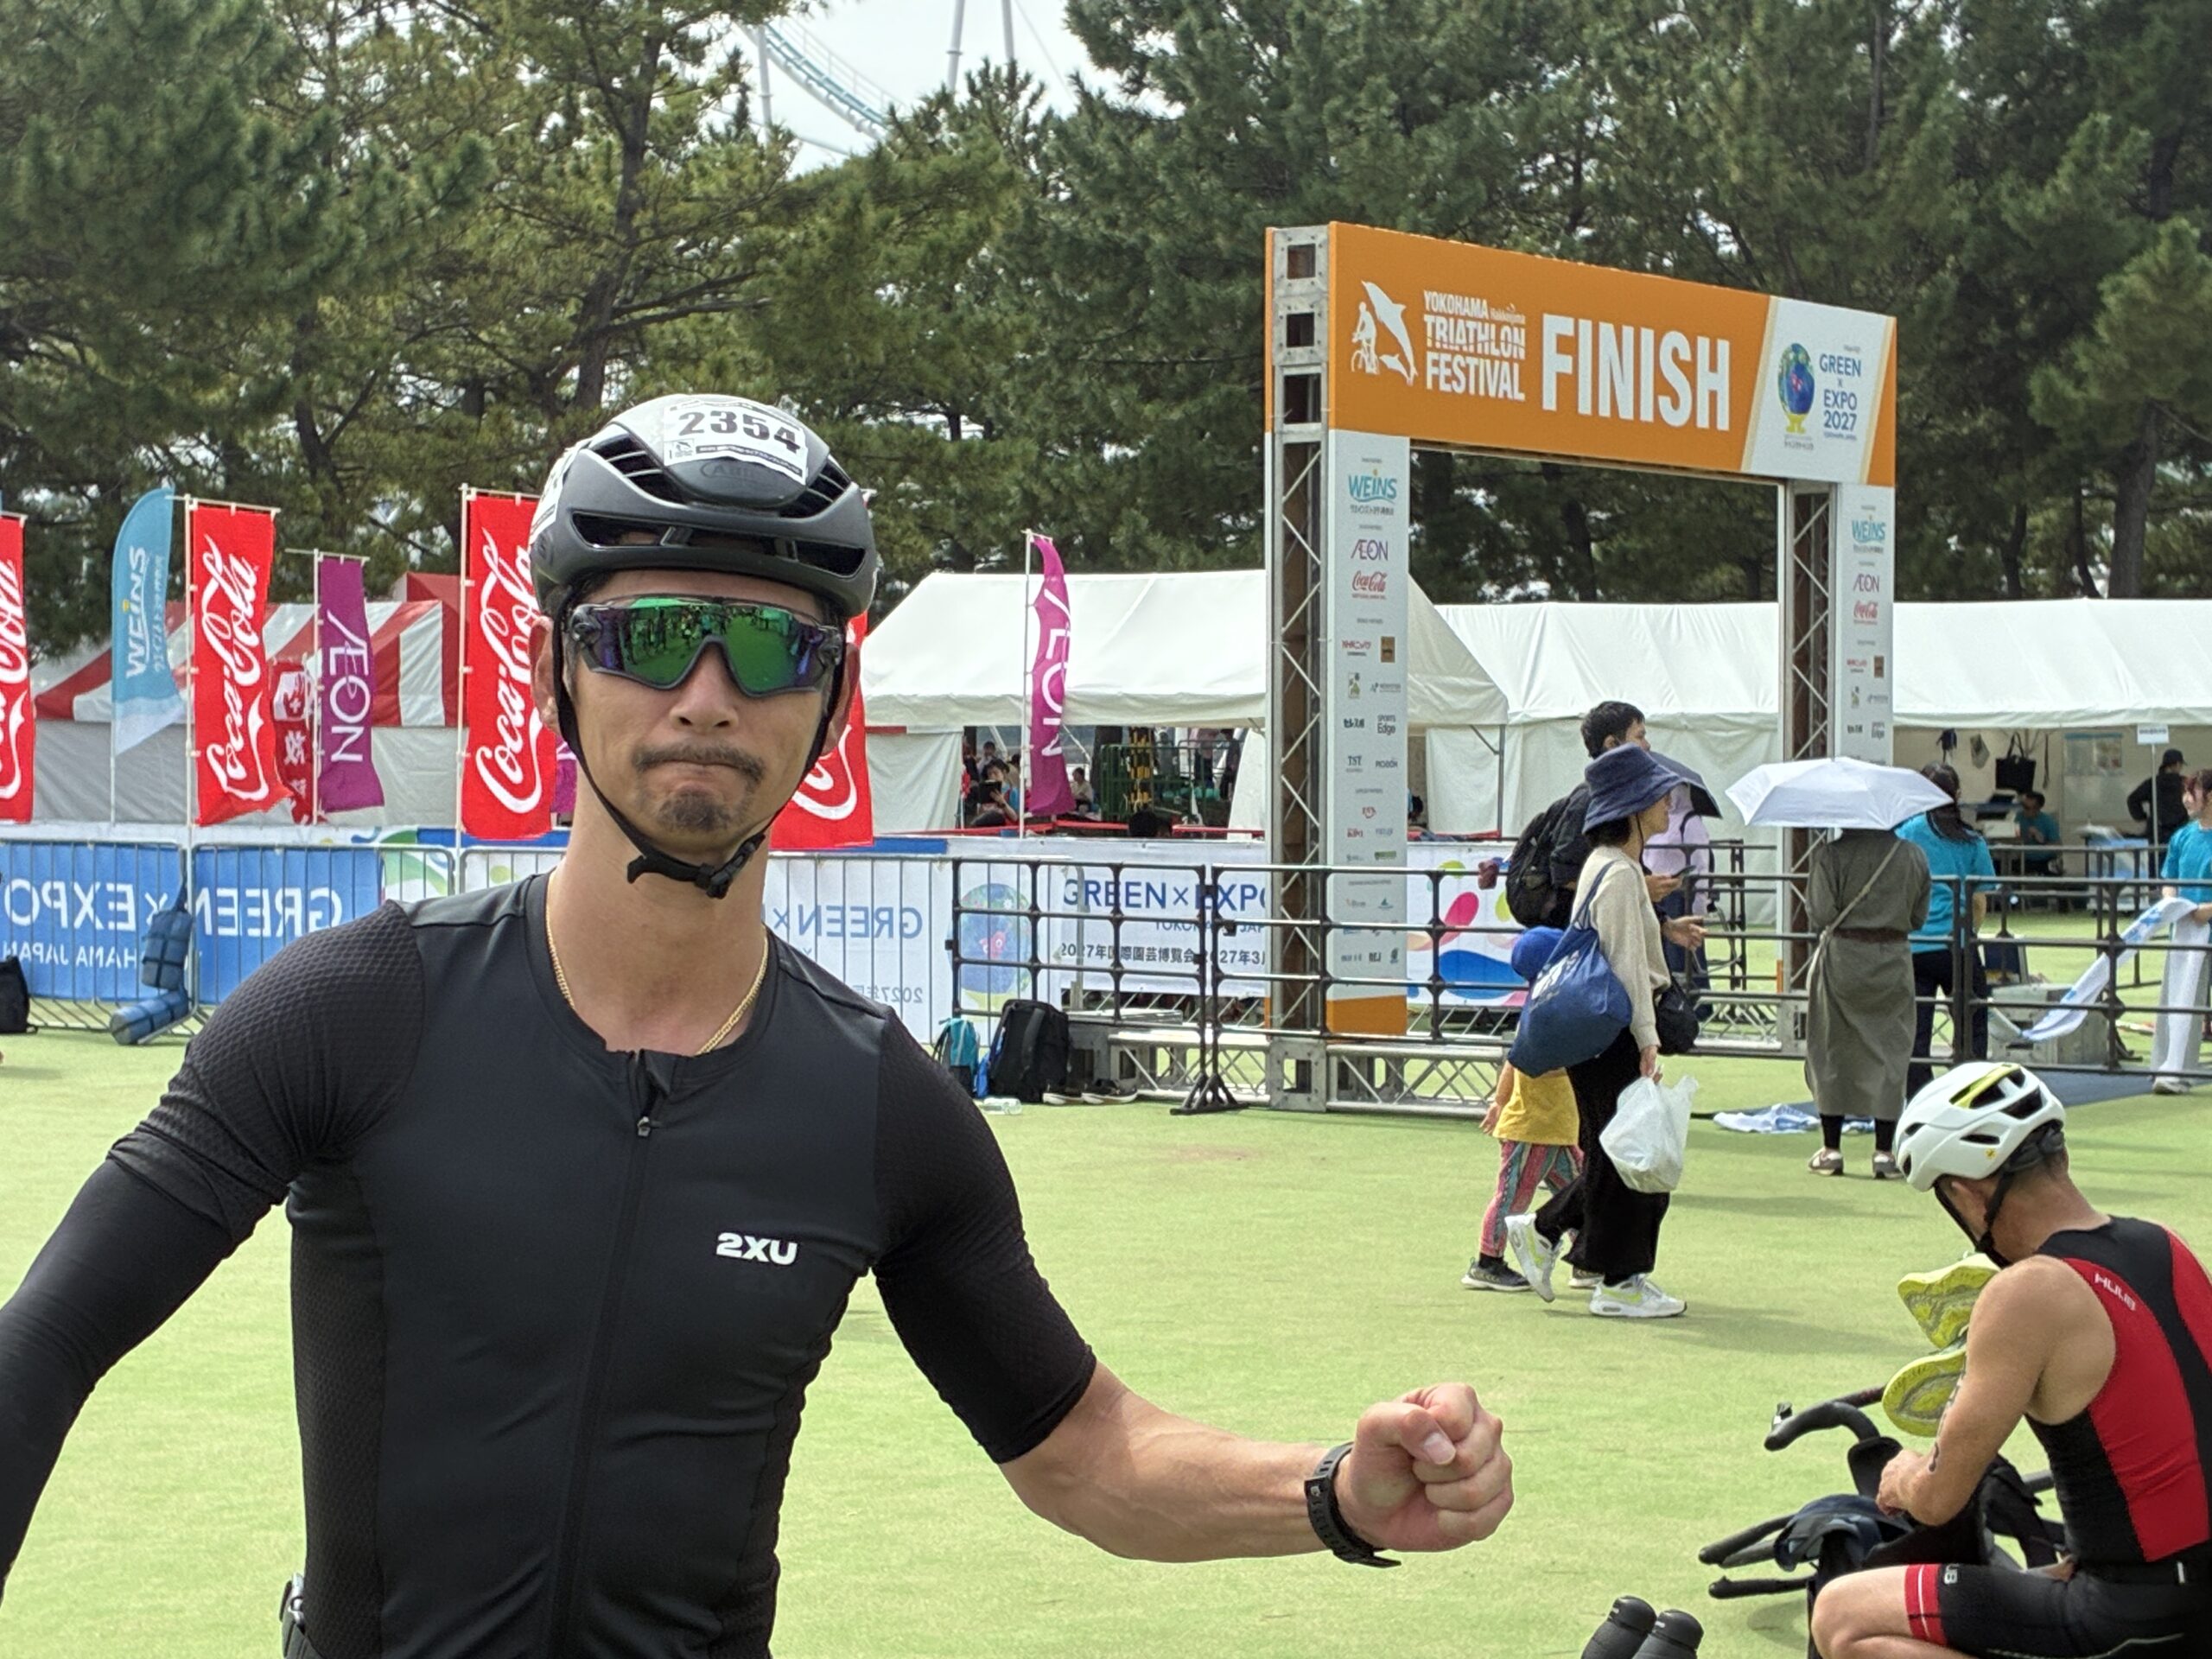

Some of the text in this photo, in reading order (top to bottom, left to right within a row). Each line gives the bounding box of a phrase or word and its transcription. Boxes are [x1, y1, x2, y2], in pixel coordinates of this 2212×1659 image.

[1423, 289, 1490, 320] YOKOHAMA
[1423, 313, 1526, 360] TRIATHLON
[1426, 350, 1526, 402] FESTIVAL
[1541, 312, 1730, 431] FINISH
[1819, 353, 1862, 378] GREEN
[1823, 389, 1858, 410] EXPO
[678, 410, 800, 454] 2354
[1823, 410, 1858, 431] 2027
[1348, 472, 1398, 501] WEINS
[126, 544, 149, 679] WEINS
[716, 1232, 798, 1265] 2XU
